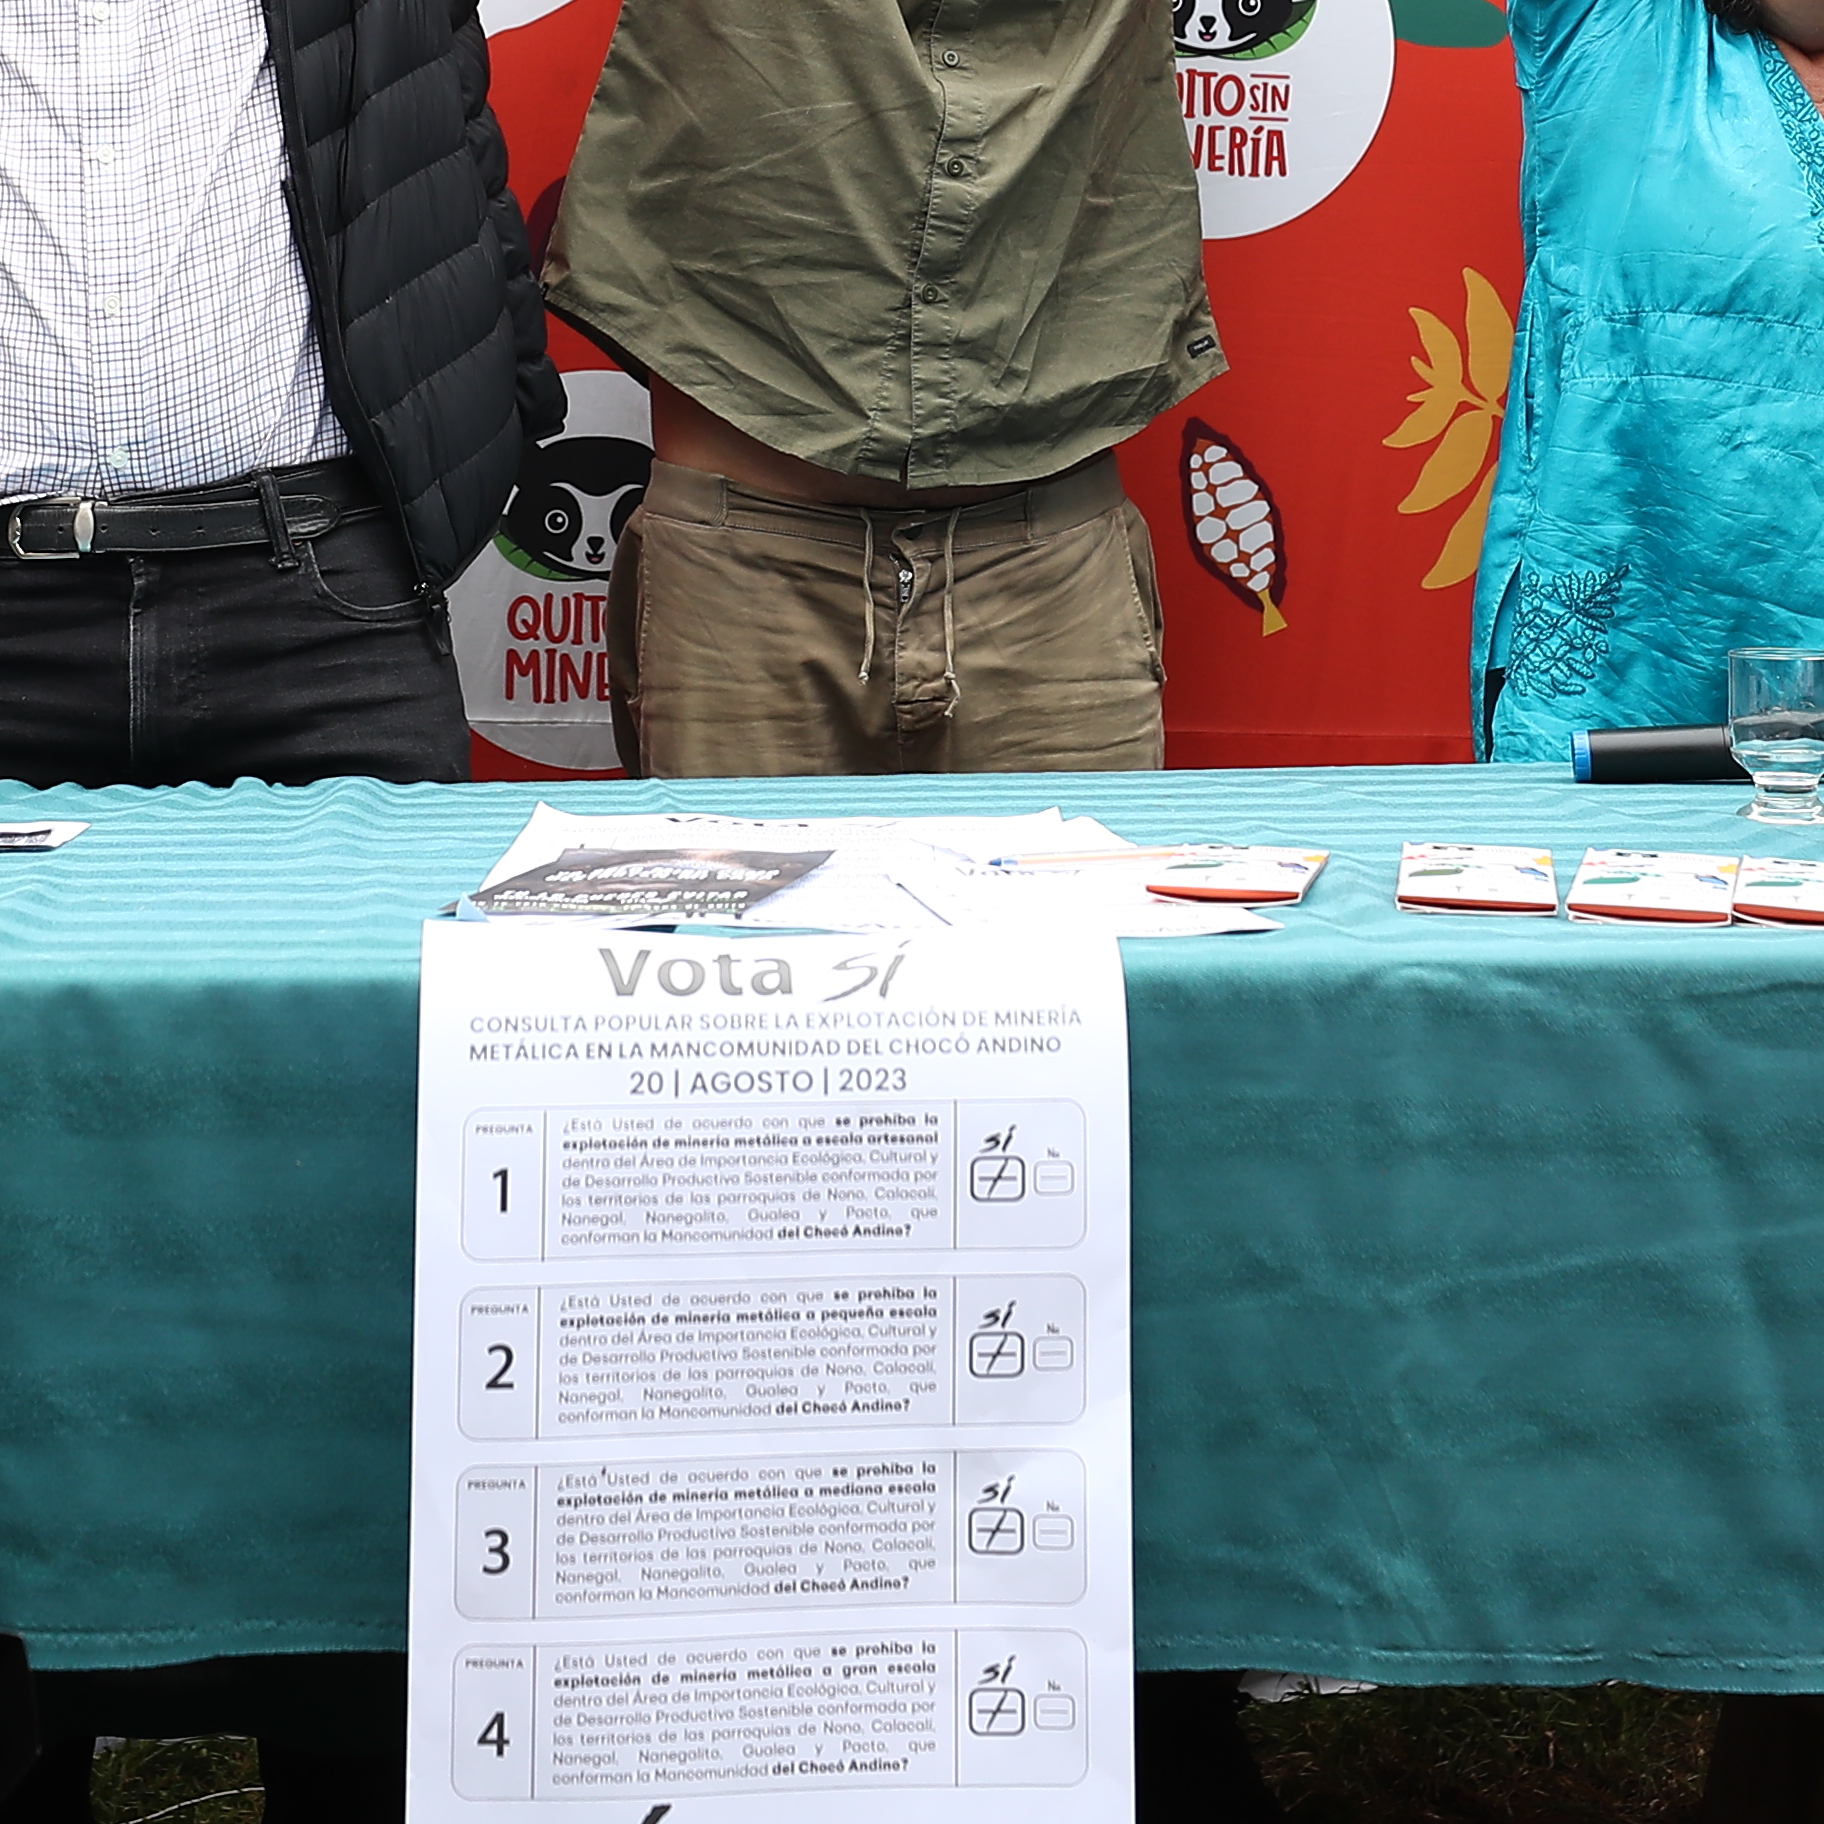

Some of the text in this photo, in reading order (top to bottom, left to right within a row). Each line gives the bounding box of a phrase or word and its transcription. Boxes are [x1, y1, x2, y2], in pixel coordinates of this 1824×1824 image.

[1177, 68, 1290, 118] ITO SIN
[1189, 125, 1287, 177] ERÍA
[507, 592, 607, 645] QUIT
[505, 648, 610, 704] MINE
[598, 948, 792, 996] Vota
[470, 1003, 1082, 1034] CONSULTA POPULAR SOBRE LA EXPLOTACIÓN DE MINERÍA
[469, 1031, 1062, 1061] METÁLICA EN LA MANCOMUNIDAD DEL CHOCÓ ANDINO
[631, 1068, 906, 1094] 20 AGOSTO 2023
[475, 1124, 533, 1135] PREGUNTA
[562, 1135, 648, 1153] explotación
[733, 1132, 798, 1147] metálica
[866, 1130, 938, 1145] artesanal
[492, 1167, 509, 1214] 1
[802, 1223, 911, 1239] Chocó Andino?
[609, 1292, 652, 1307] Usted
[661, 1291, 680, 1305] de
[689, 1290, 751, 1305] acuerdo
[760, 1292, 787, 1303] con
[796, 1291, 824, 1305] que
[833, 1291, 849, 1301] se
[922, 1285, 937, 1299] la
[470, 1304, 529, 1316] PREGUNTA
[559, 1311, 646, 1330] explotación
[650, 1310, 669, 1324] de
[735, 1307, 801, 1322] metálica
[805, 1310, 815, 1321] a
[820, 1305, 884, 1324] pequeña
[888, 1304, 937, 1319] escala
[559, 1331, 608, 1346] dentro
[610, 1331, 634, 1345] del
[637, 1330, 672, 1344] Área
[675, 1329, 694, 1343] de
[697, 1327, 787, 1346] Importancia
[867, 1323, 926, 1338] Cultural
[558, 1342, 937, 1365] de Desarrollo Productivo Sostenible conformada por
[485, 1344, 515, 1391] 2
[558, 1370, 579, 1384] los
[585, 1368, 656, 1383] territorios
[662, 1367, 681, 1381] de
[687, 1366, 708, 1380] las
[714, 1364, 794, 1383] parroquias
[800, 1363, 819, 1377] de
[745, 1382, 798, 1397] Gualea
[909, 1382, 937, 1396] que
[557, 1398, 910, 1421] conforman la Mancomunidad del Chocó Andino?
[467, 1479, 526, 1491] PREGUNTA
[556, 1489, 643, 1509] explotación
[733, 1484, 799, 1499] metálica
[818, 1481, 883, 1497] mediana
[482, 1528, 511, 1576] 3
[799, 1574, 909, 1592] Chocó Andino?
[464, 1658, 524, 1671] PREGUNTA
[552, 1670, 641, 1691] explotación
[746, 1664, 812, 1680] metálica
[841, 1665, 877, 1680] gran
[477, 1712, 510, 1759] 4
[798, 1756, 908, 1774] Chocó Andino?
